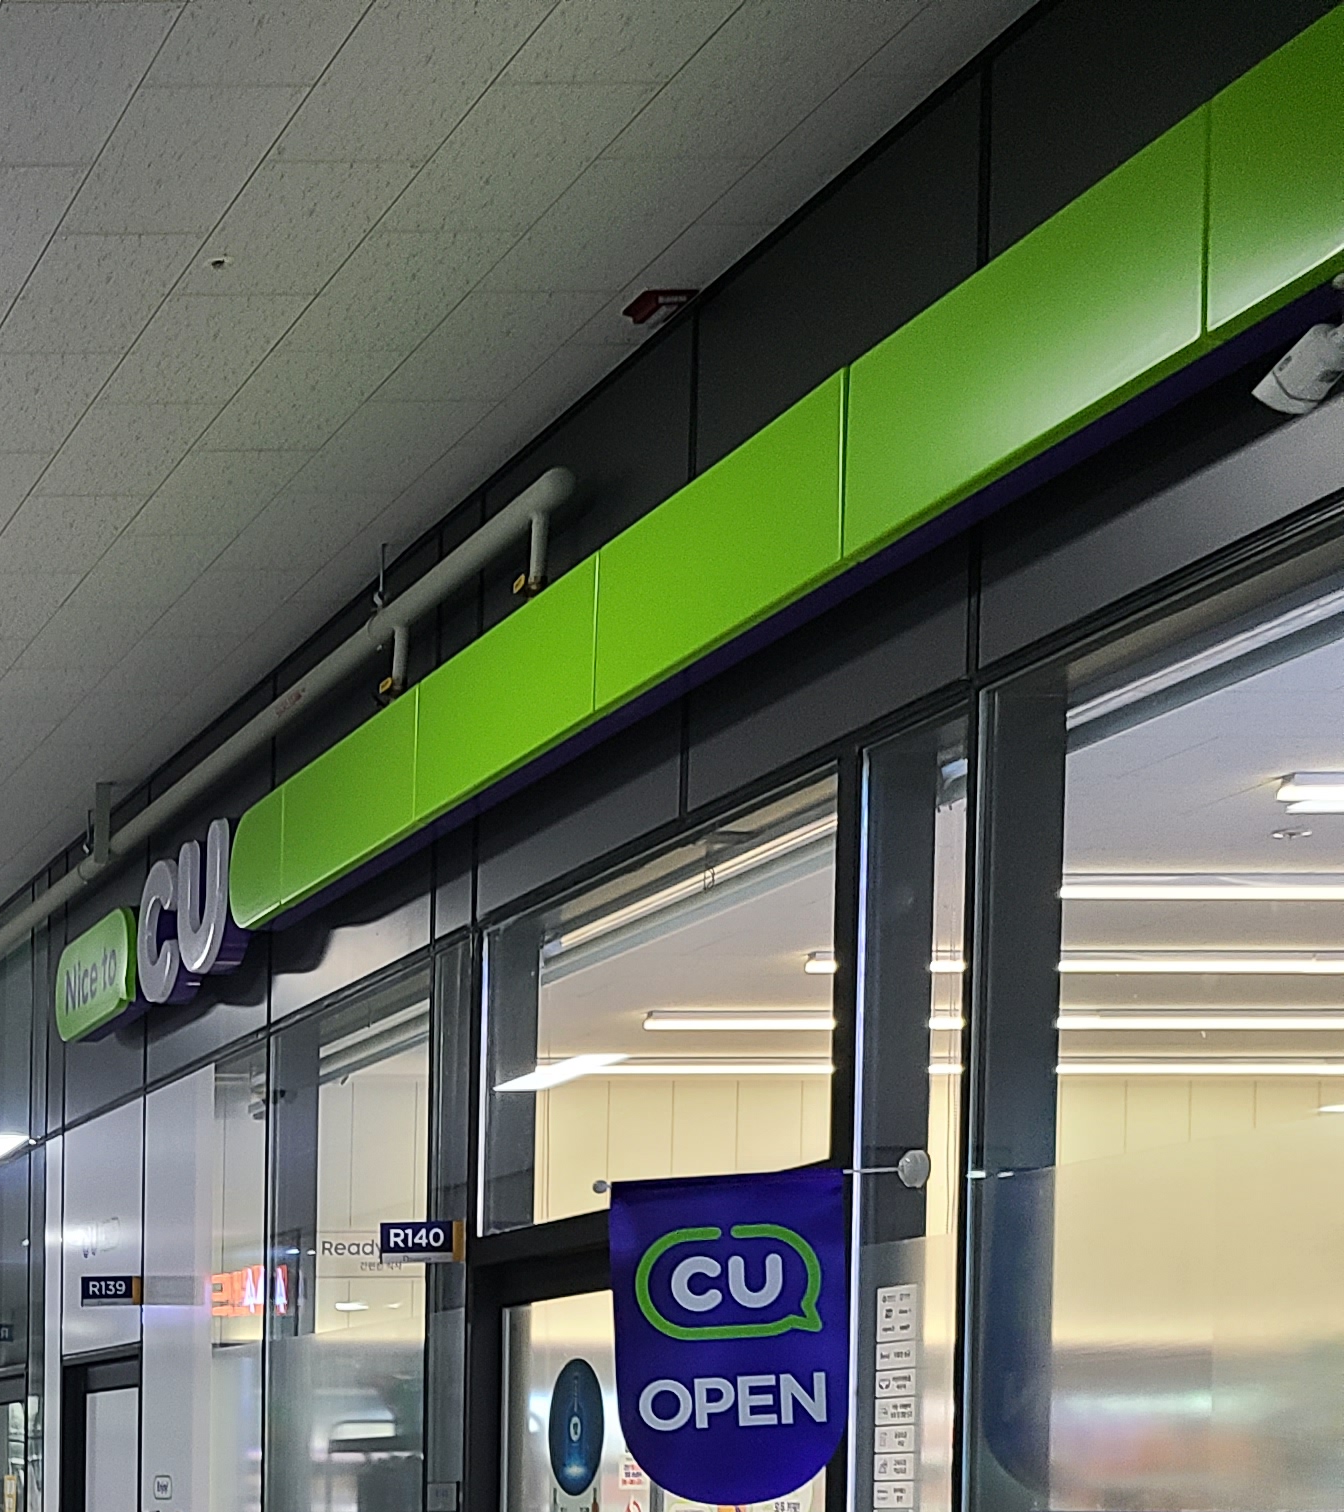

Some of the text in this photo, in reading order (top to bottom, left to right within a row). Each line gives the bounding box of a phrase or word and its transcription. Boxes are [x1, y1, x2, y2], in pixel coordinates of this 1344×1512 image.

[65, 818, 230, 1016] Nice to CU
[389, 1228, 445, 1248] R140
[89, 1281, 126, 1295] R139
[671, 1253, 783, 1312] CU
[638, 1371, 827, 1432] OPEN
